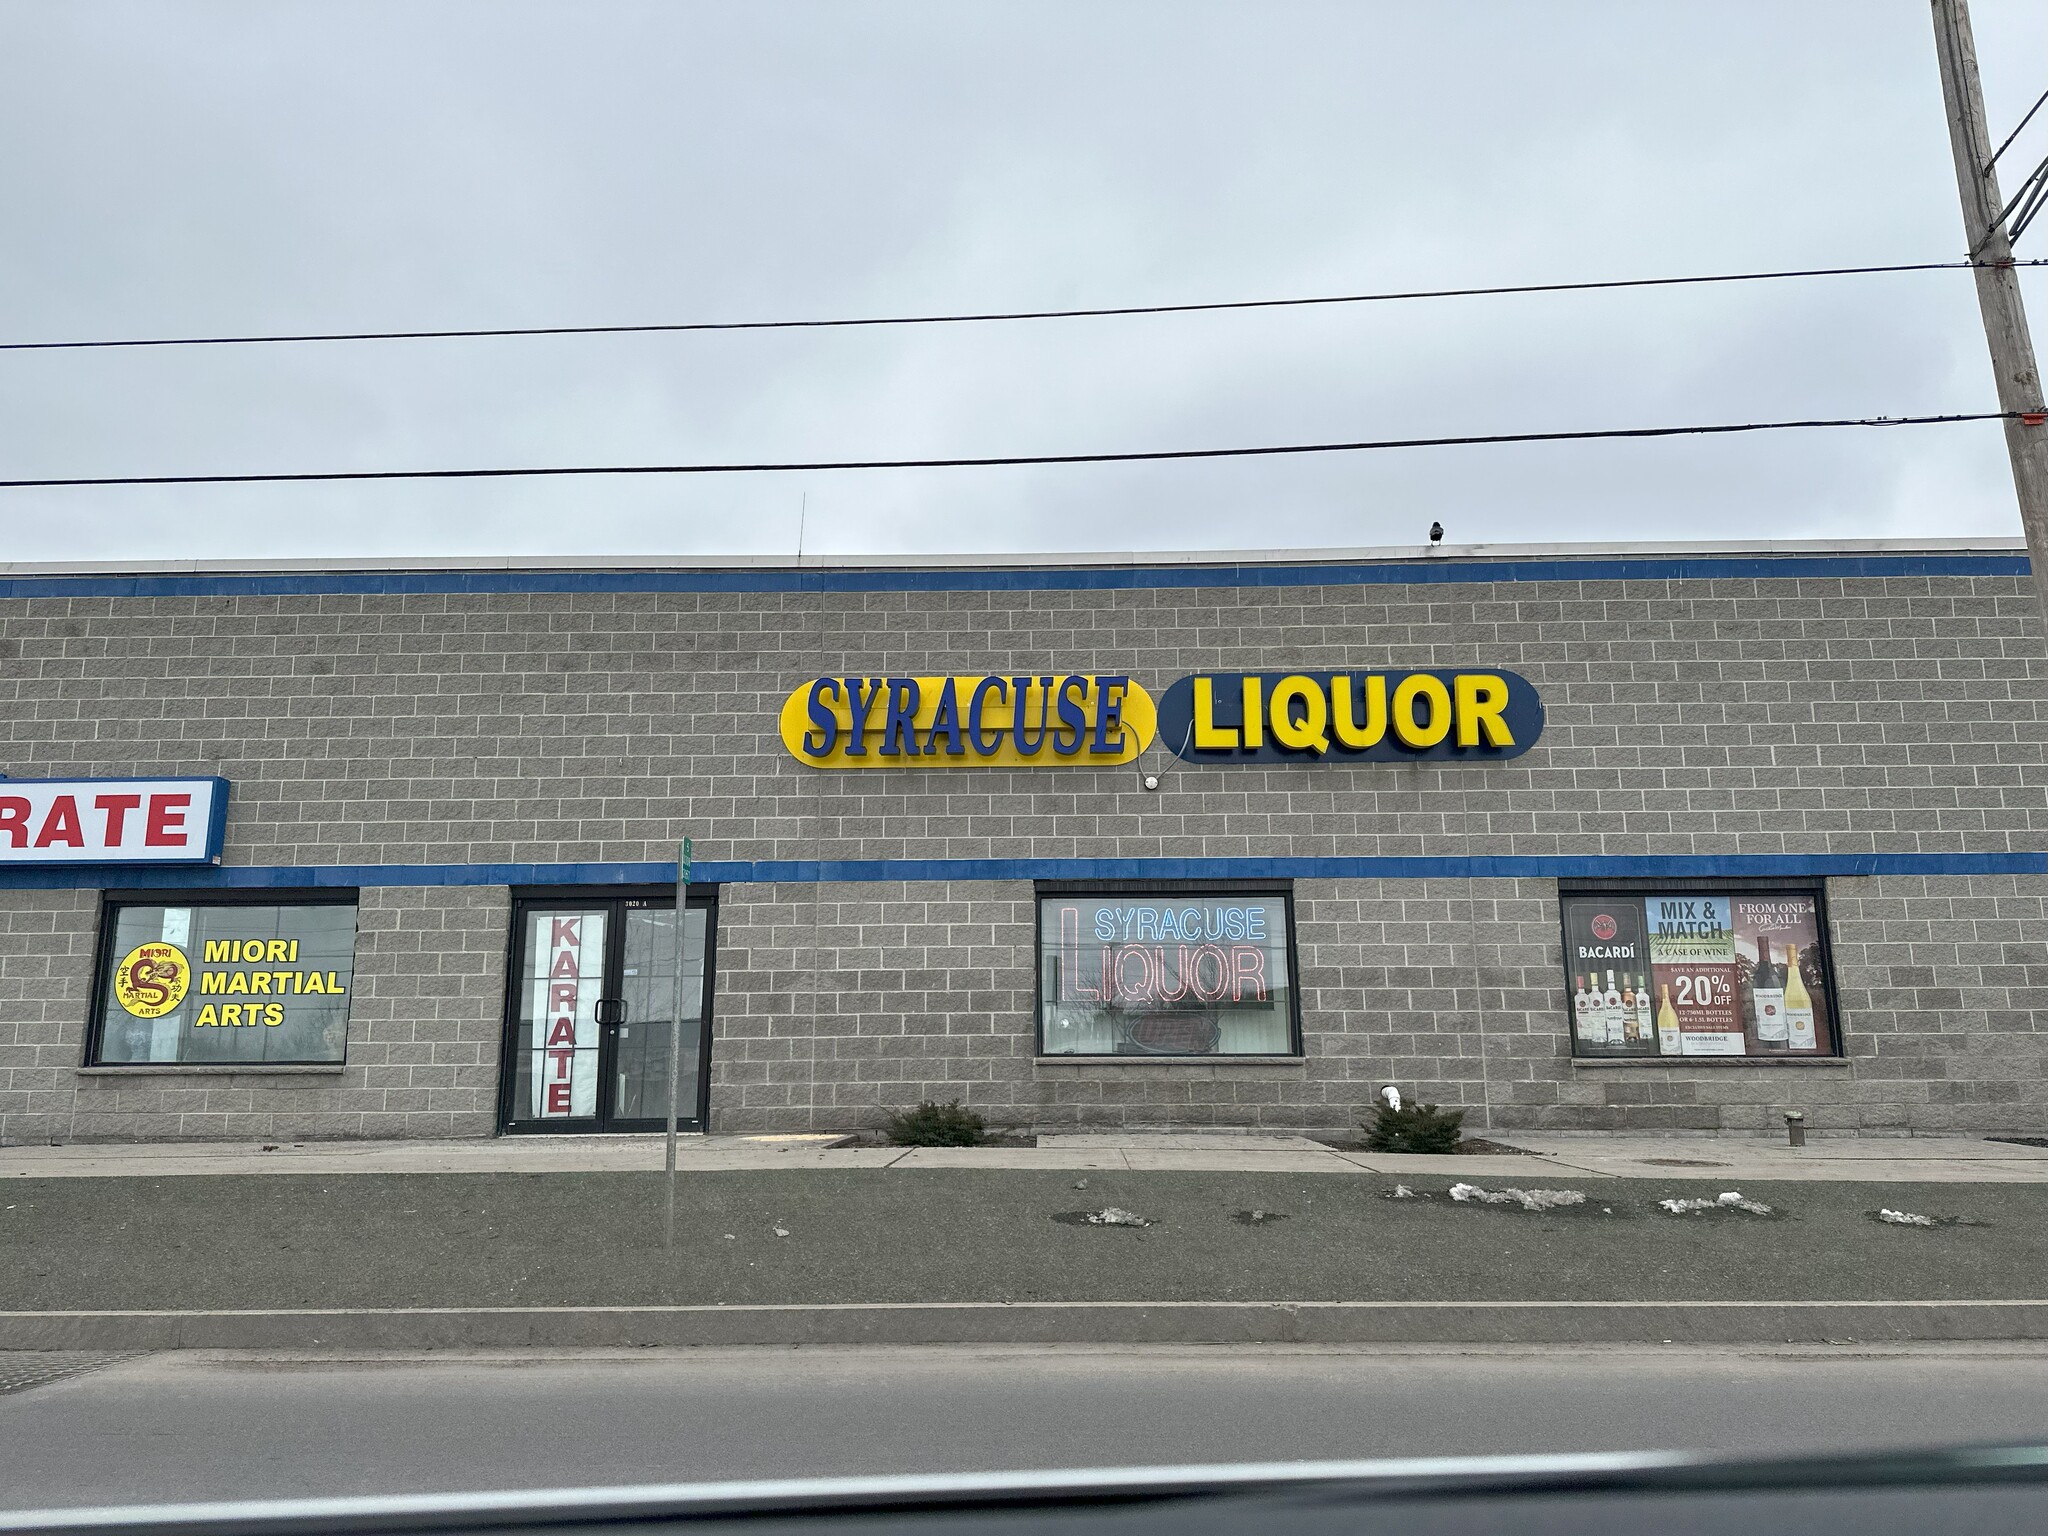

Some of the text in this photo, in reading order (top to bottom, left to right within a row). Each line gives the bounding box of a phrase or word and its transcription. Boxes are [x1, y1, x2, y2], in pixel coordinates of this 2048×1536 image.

[802, 673, 1517, 756] SYRACUSE LIQUOR
[0, 794, 191, 848] RATE
[1661, 901, 1716, 919] MIX &
[1739, 903, 1807, 914] FROM ONE
[1747, 914, 1801, 924] FOR ALL
[1095, 908, 1266, 940] SYRACUSE
[1658, 921, 1723, 940] MATCH
[139, 949, 172, 958] MIORI
[204, 940, 299, 963] MIORI
[1062, 908, 1266, 1004] LIQUOR
[1579, 942, 1635, 958] BACARDÍ
[1665, 948, 1688, 956] CASE
[1690, 948, 1702, 956] OF
[1704, 948, 1729, 956] WINE
[200, 971, 345, 995] MARTIAL
[1675, 975, 1730, 1006] 20%
[1714, 995, 1732, 1005] OFF
[195, 1003, 285, 1027] ARTS
[547, 918, 579, 1113] KARATE
